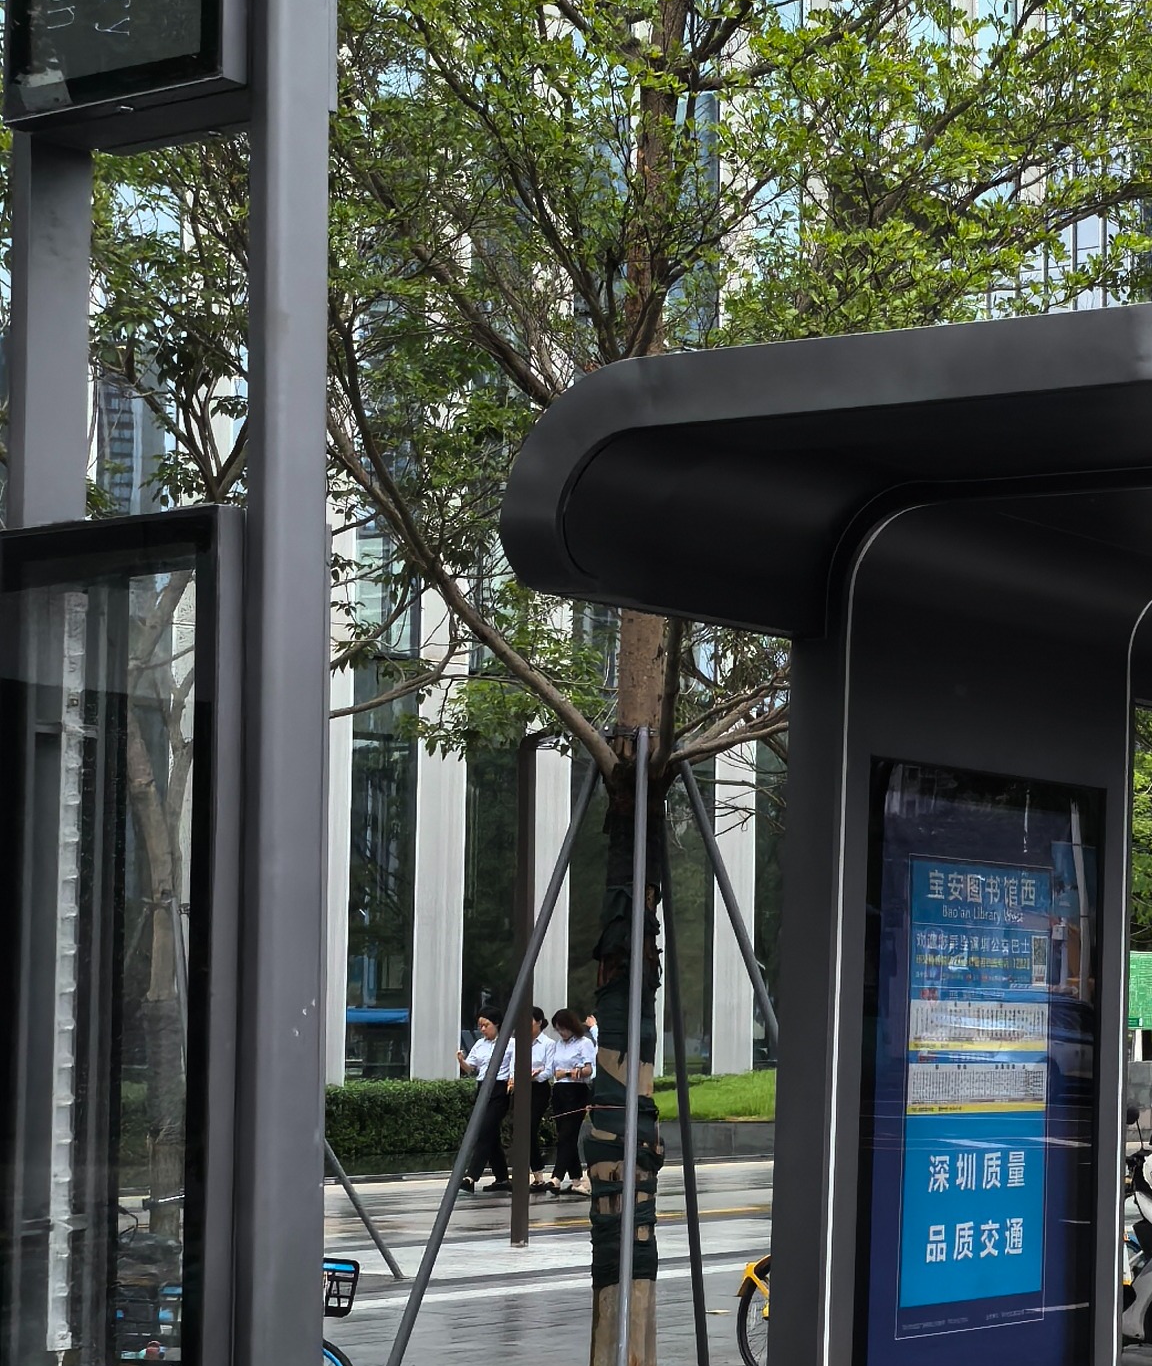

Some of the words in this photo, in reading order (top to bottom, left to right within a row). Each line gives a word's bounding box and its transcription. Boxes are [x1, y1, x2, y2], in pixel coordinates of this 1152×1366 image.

[926, 869, 1036, 908] 宝安图书馆西
[928, 1150, 1026, 1193] 深圳质量
[925, 1217, 1024, 1264] 品质交通
